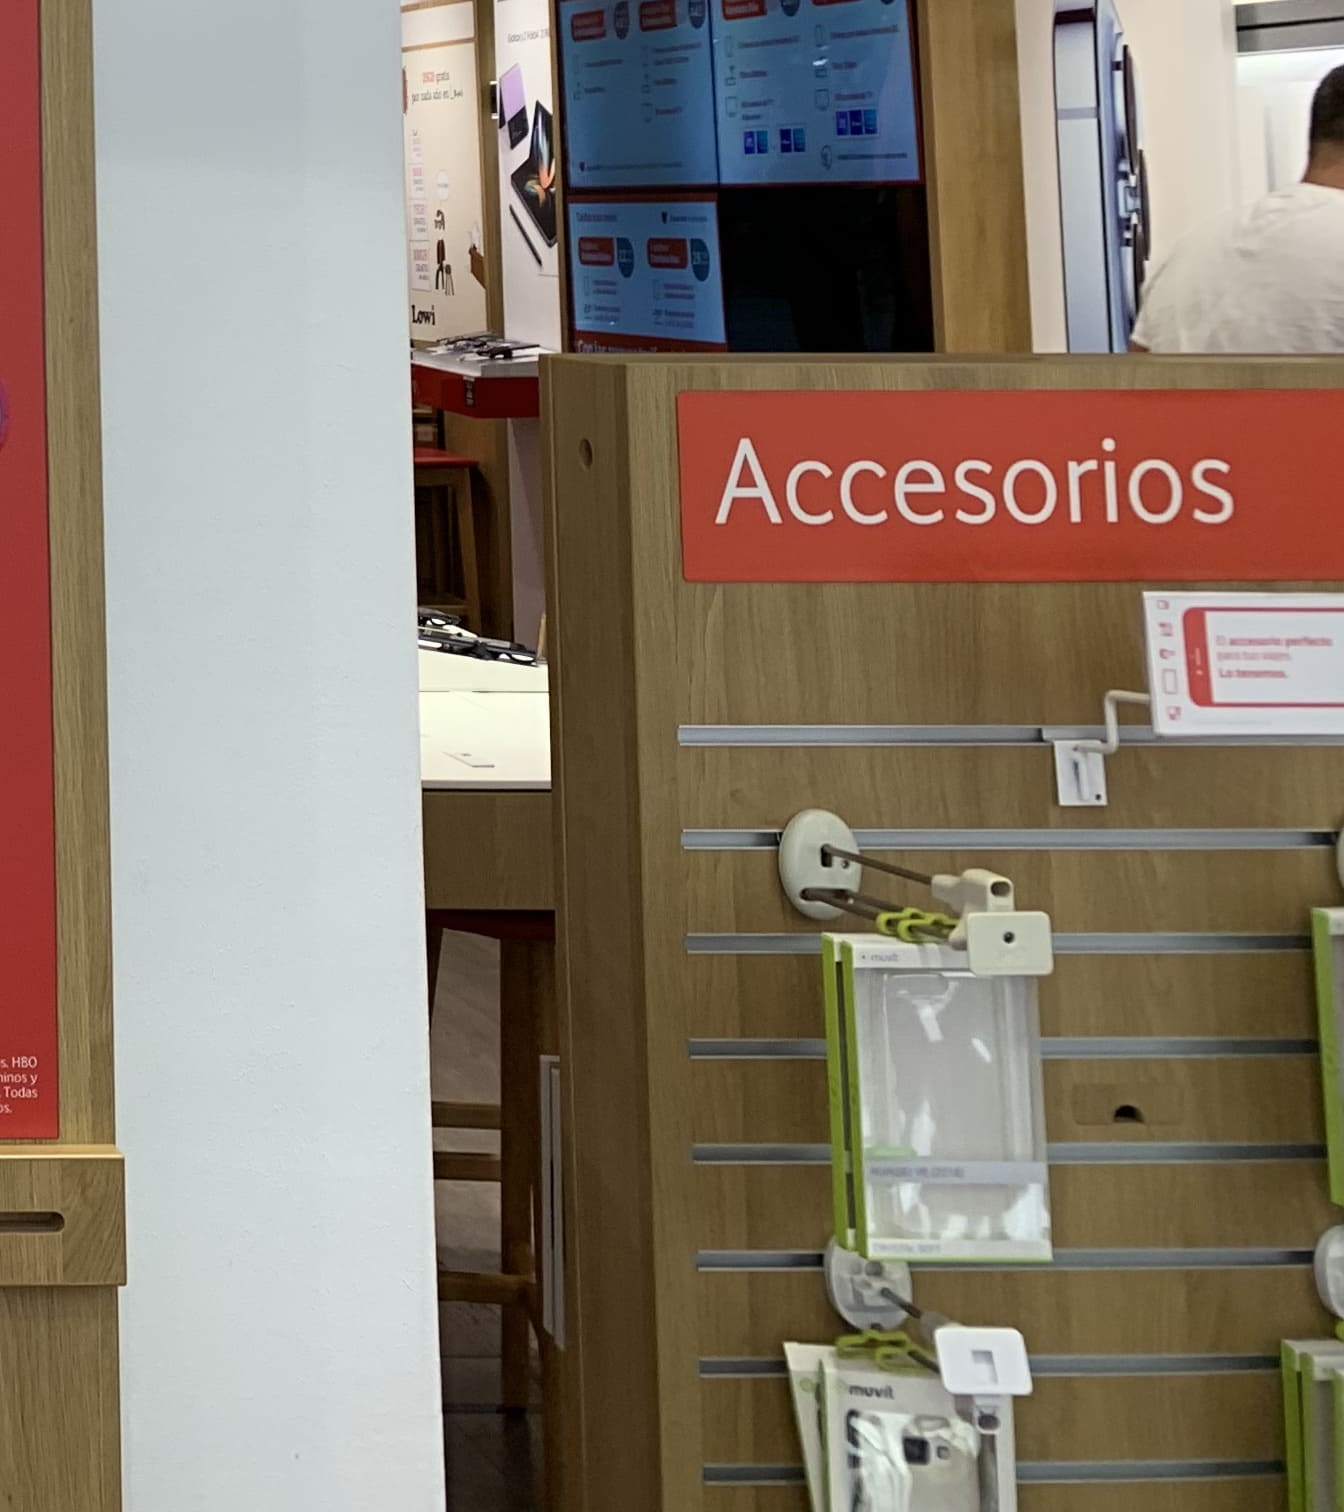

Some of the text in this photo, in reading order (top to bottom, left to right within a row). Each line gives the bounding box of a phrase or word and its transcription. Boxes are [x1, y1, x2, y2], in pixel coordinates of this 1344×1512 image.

[716, 438, 1235, 526] Accesorios
[11, 1055, 38, 1069] HBO
[30, 1073, 38, 1087] y
[4, 1085, 38, 1099] Todas
